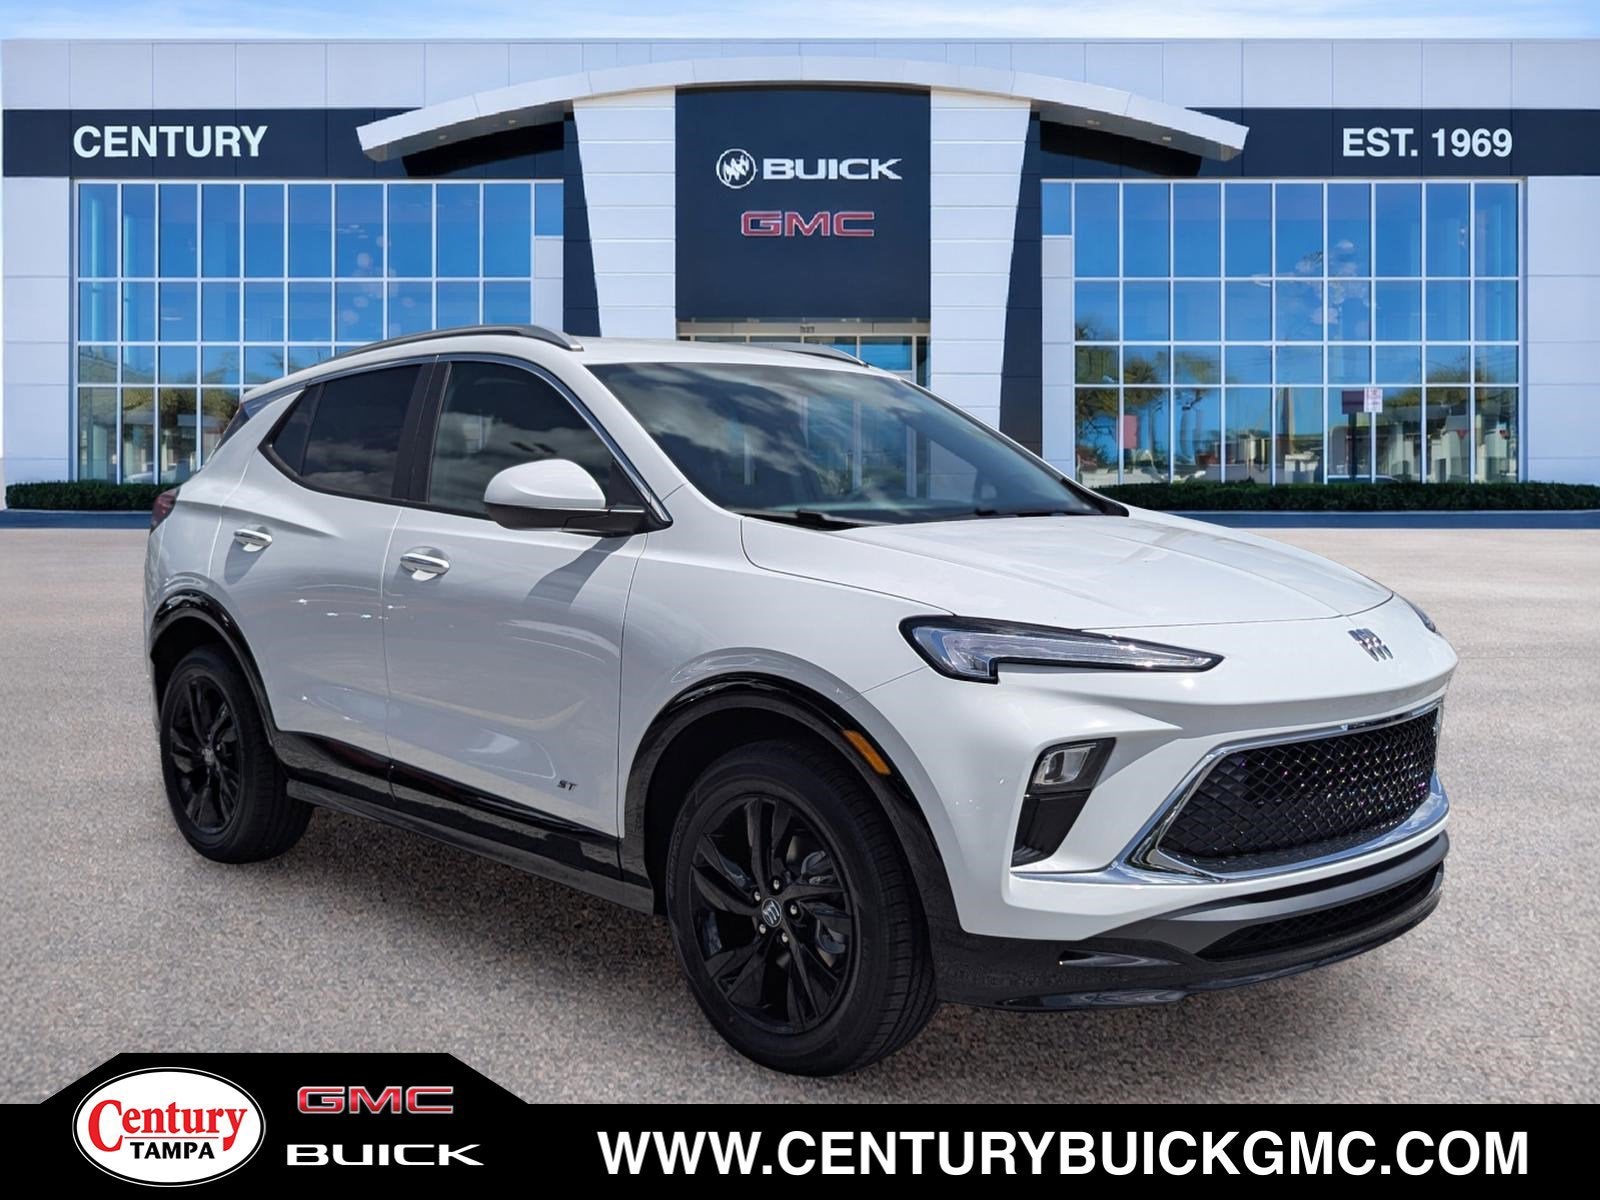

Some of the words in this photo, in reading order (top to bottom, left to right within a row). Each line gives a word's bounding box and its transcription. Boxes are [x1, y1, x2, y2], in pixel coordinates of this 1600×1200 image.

[73, 125, 267, 158] CENTURY
[1342, 127, 1418, 157] EST.
[1431, 128, 1513, 158] 1969
[763, 158, 902, 180] BUICK
[741, 210, 875, 237] GMC
[557, 780, 578, 790] ST
